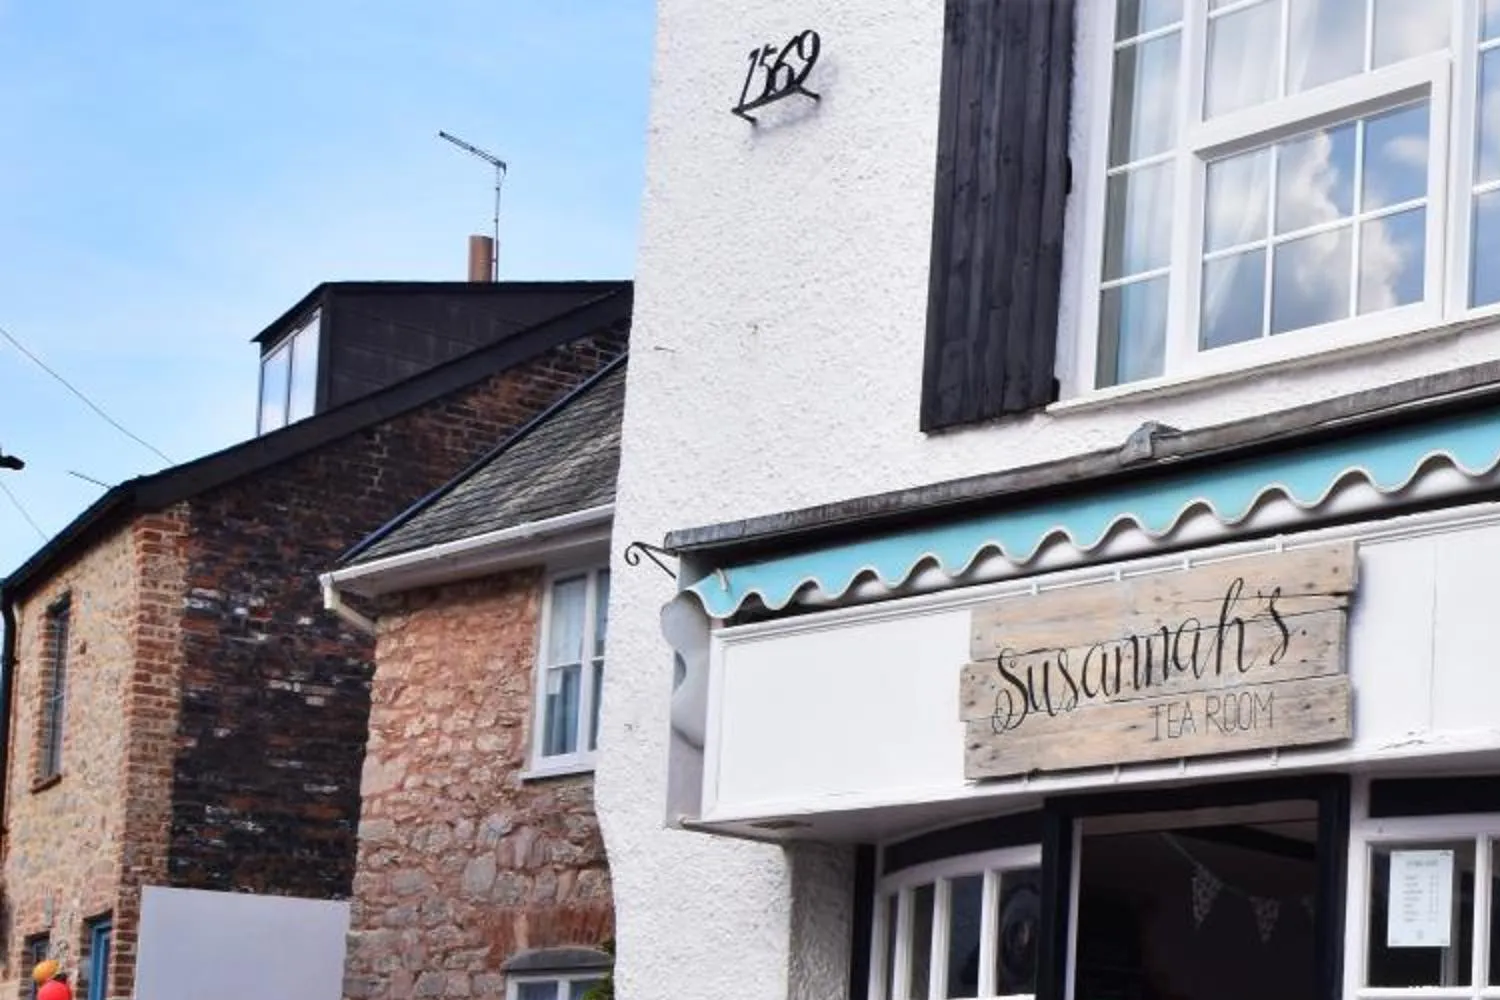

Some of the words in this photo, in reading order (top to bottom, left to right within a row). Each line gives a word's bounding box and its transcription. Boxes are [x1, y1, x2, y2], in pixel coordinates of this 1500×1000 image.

[990, 577, 1290, 735] Susannah's
[1150, 701, 1197, 742] TEA
[1203, 692, 1275, 734] ROOM
